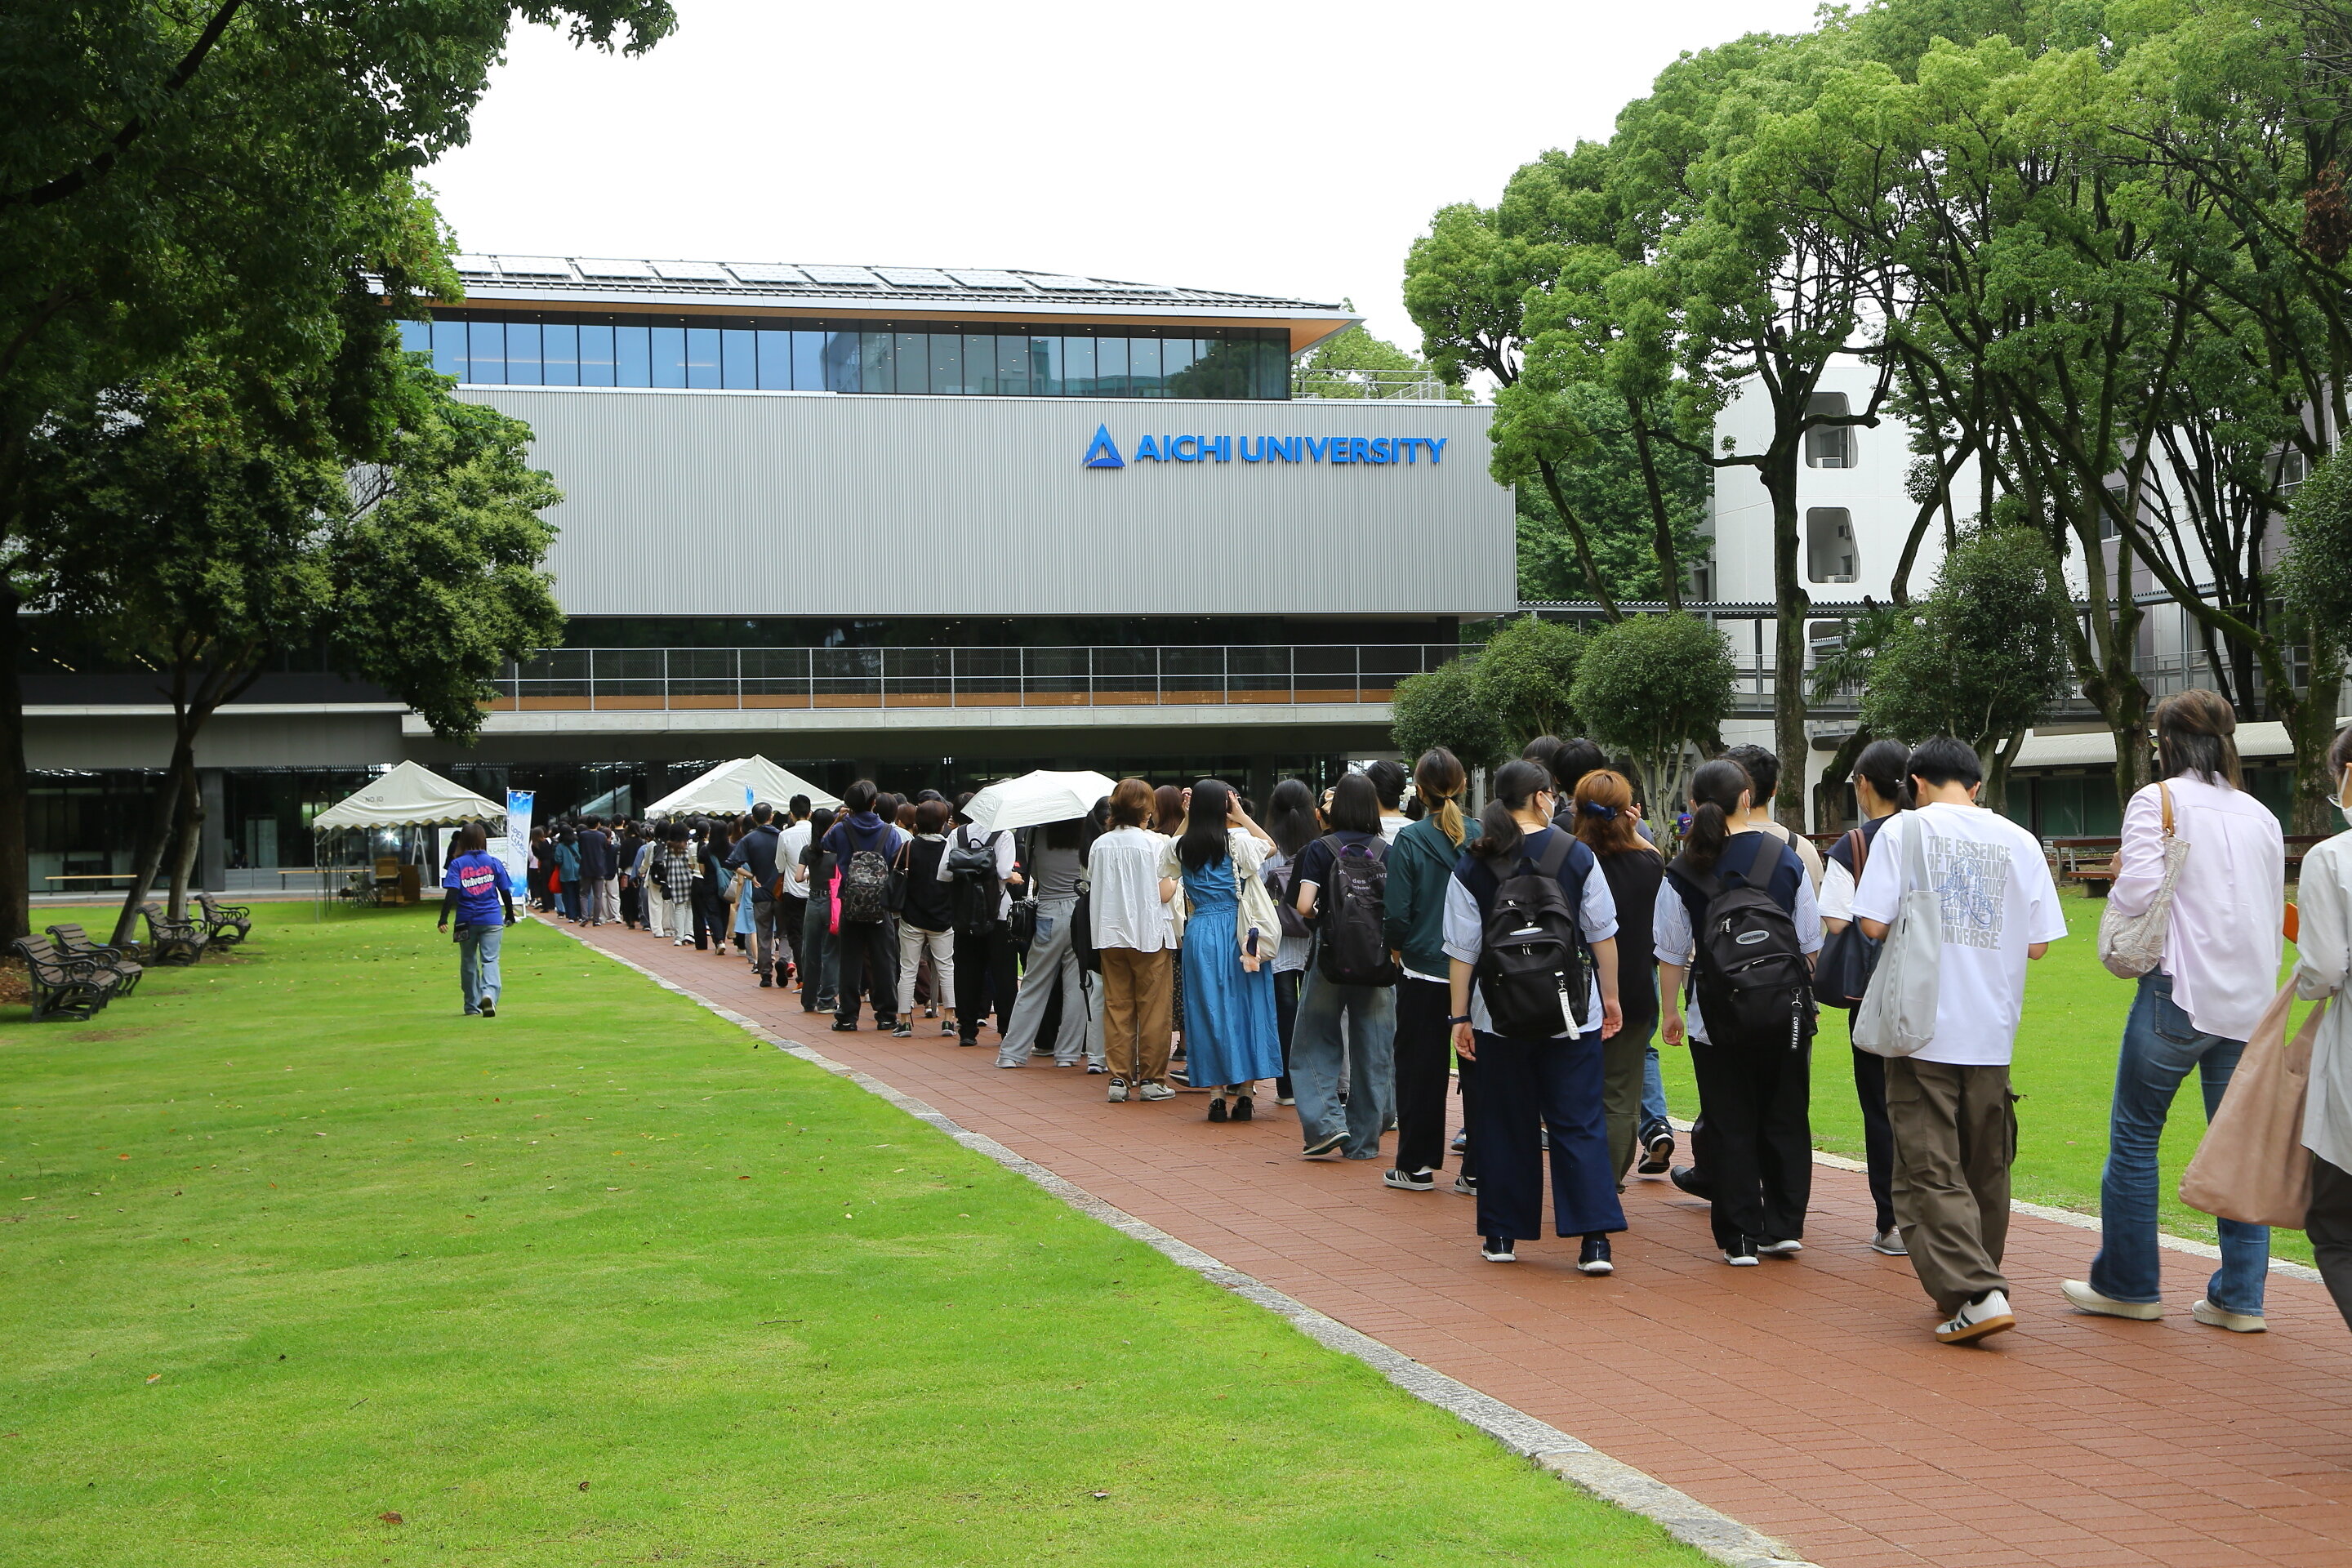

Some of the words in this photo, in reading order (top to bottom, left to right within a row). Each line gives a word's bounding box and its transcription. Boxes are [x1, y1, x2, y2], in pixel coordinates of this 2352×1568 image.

[1134, 434, 1231, 461] AICHI
[1240, 436, 1448, 463] UNIVERSITY
[1927, 835, 1951, 854] THE
[1955, 839, 2011, 863] ESSENCE
[1927, 853, 1942, 871] OF
[1940, 925, 2001, 950] NVERSE.
[1791, 1016, 1799, 1049] CONVERSE
